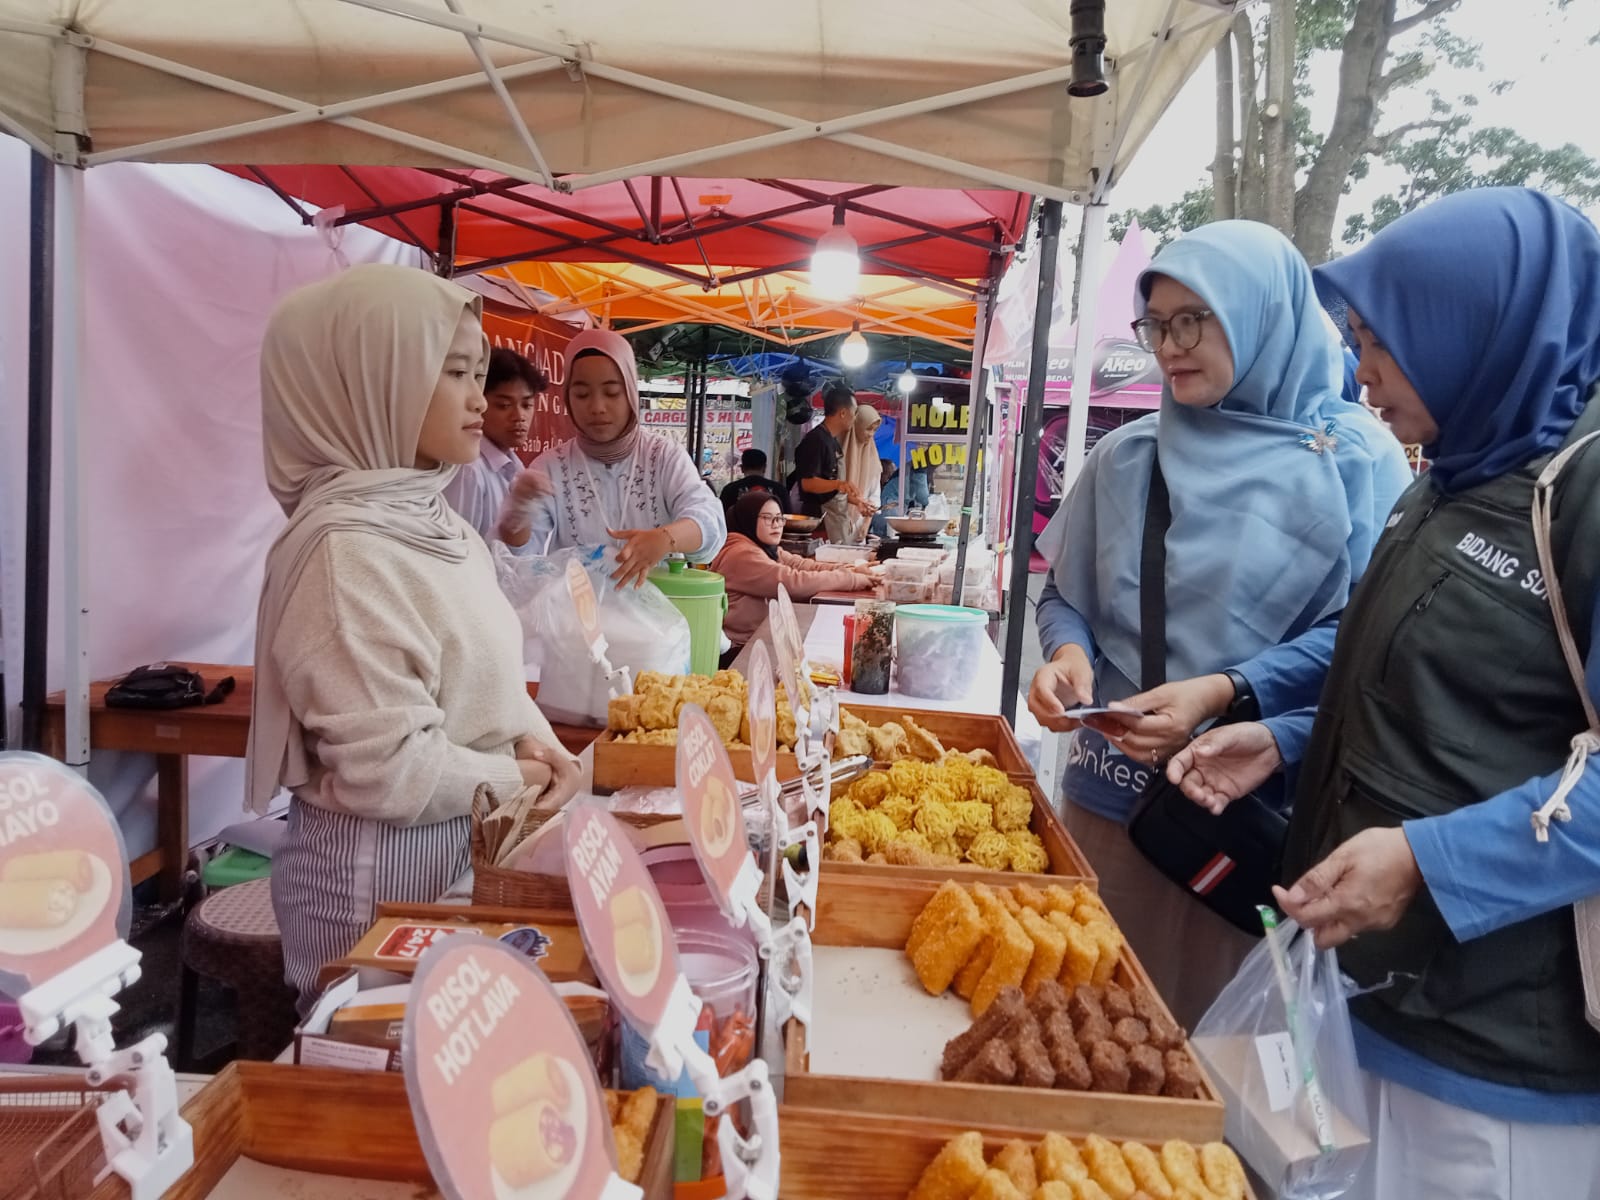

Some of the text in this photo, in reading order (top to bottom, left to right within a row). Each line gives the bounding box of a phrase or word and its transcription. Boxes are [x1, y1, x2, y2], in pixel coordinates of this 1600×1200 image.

[1100, 357, 1146, 373] Akeo
[644, 412, 715, 423] CARGLS
[1456, 532, 1519, 578] BIDANG
[572, 814, 609, 877] RISOL
[588, 839, 623, 911] AYAM
[427, 955, 491, 1031] RISOL
[434, 973, 521, 1086] HOT LAVA
